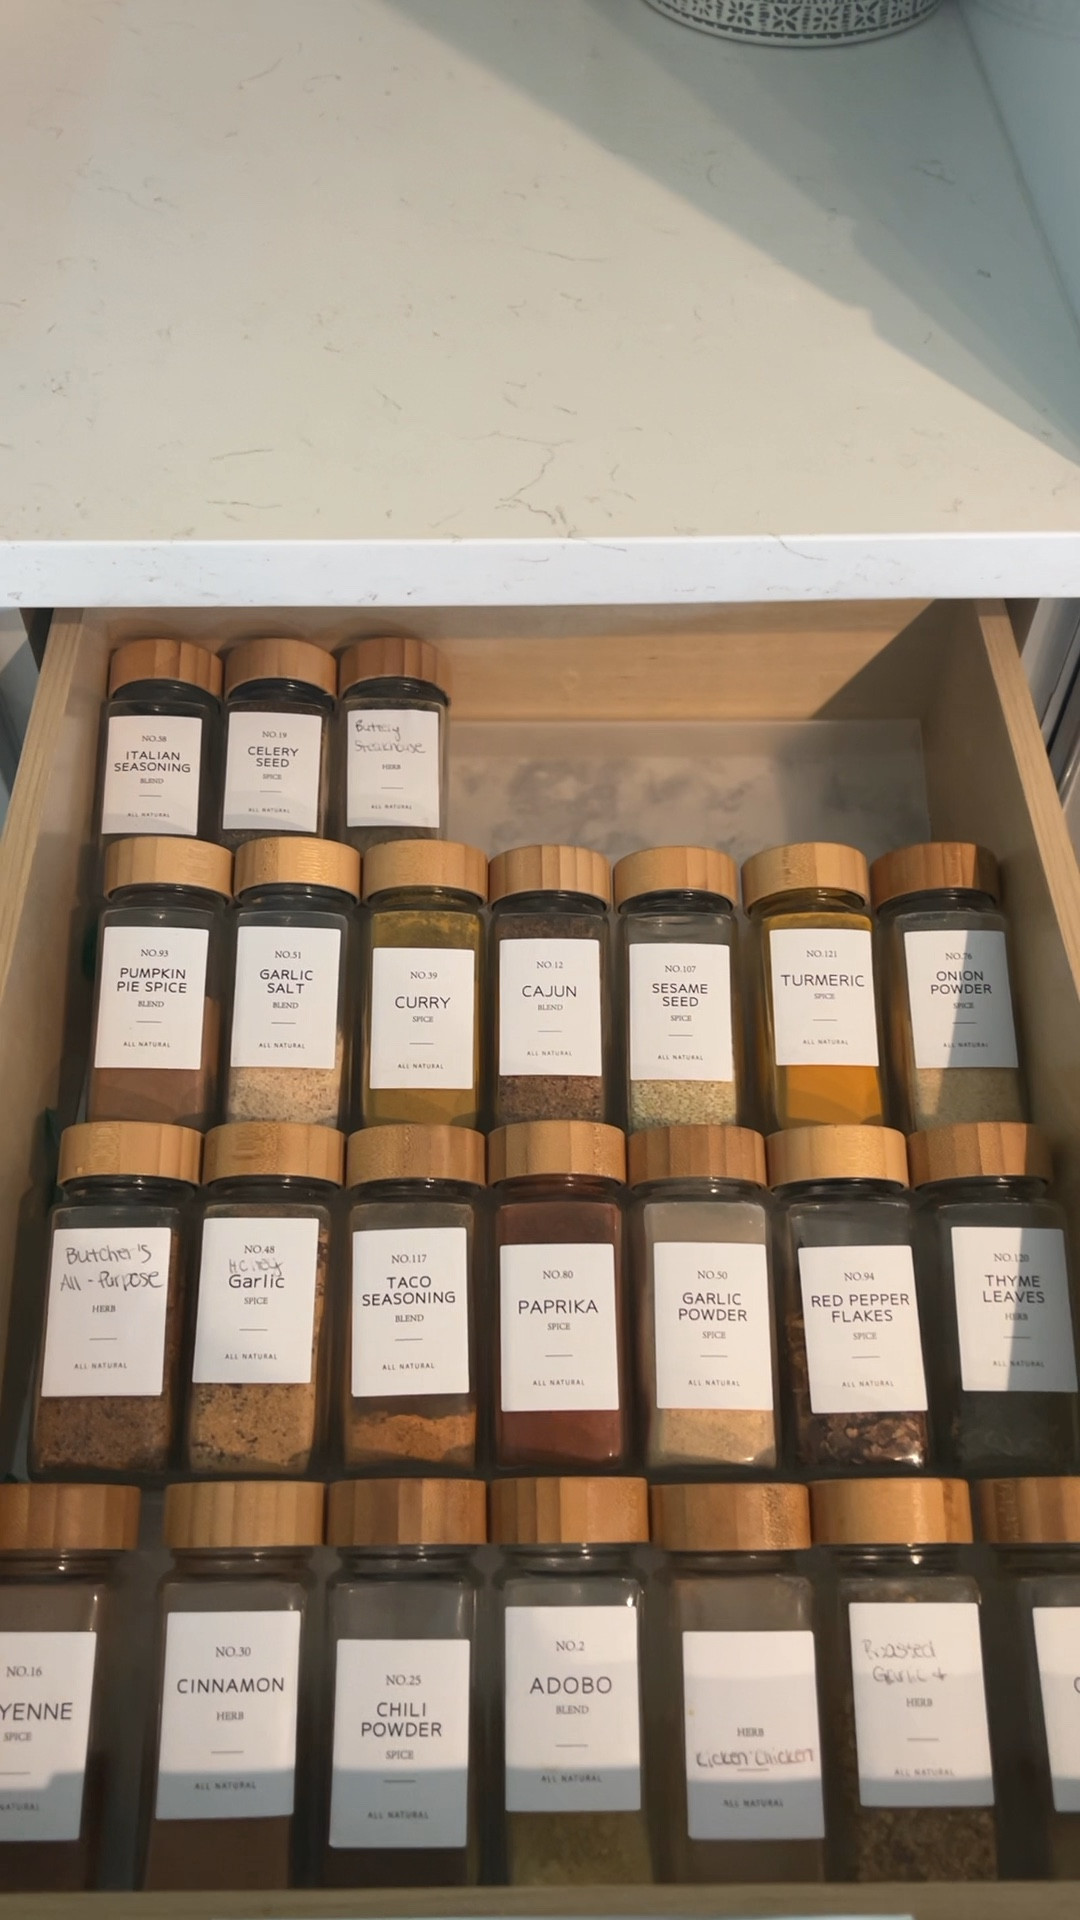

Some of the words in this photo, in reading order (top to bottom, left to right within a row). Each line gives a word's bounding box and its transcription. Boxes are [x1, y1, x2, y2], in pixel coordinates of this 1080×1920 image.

[248, 746, 299, 756] CELERY
[126, 751, 180, 763] ITALIAN
[114, 762, 190, 773] SEASONING
[256, 758, 289, 767] SEED
[141, 949, 168, 957] NO.93
[275, 951, 301, 959] NO.51
[806, 950, 837, 958] NO.121
[536, 961, 563, 969] NO.12
[665, 965, 696, 973] NO.107
[120, 968, 185, 982] PUMPKIN
[260, 969, 313, 981] GARLIC
[411, 971, 438, 979] NO.39
[936, 971, 983, 981] ONION
[781, 974, 864, 987] TURMERIC
[117, 981, 140, 992] PIE
[145, 981, 187, 993] SPICE
[267, 983, 304, 994] SALT
[522, 986, 576, 997] CAJUN
[652, 983, 707, 997] SESAME
[931, 984, 992, 994] POWDER
[395, 996, 450, 1008] CURRY
[662, 996, 698, 1007] SEED
[244, 1245, 275, 1254] NO.48
[392, 1254, 427, 1264] NO.117
[993, 1253, 1029, 1262] NO.120
[543, 1270, 573, 1279] NO.80
[697, 1270, 728, 1280] NO.50
[844, 1272, 874, 1281] NO.94
[229, 1272, 284, 1288] Garlic
[387, 1276, 431, 1288] TACO
[984, 1275, 1040, 1287] THYME
[244, 1297, 268, 1305] SPICE
[362, 1291, 455, 1306] SEASONING
[683, 1292, 741, 1305] GARLIC
[811, 1295, 843, 1307] RED
[849, 1293, 910, 1306] PEPPER
[983, 1290, 1044, 1303] LEAVES
[519, 1300, 598, 1314] PAPRIKA
[395, 1314, 424, 1323] BLEND
[679, 1308, 747, 1321] POWDER
[832, 1310, 893, 1323] FLAKES
[547, 1322, 570, 1330] SPICE
[702, 1331, 726, 1339] SPICE
[853, 1332, 877, 1340] SPICE
[556, 1641, 584, 1651] NO.2
[216, 1646, 251, 1657] NO.30
[6, 1666, 42, 1677] NO.16
[386, 1675, 421, 1686] NO.25
[530, 1676, 612, 1694] ADOBO
[177, 1678, 284, 1694] CINNAMON
[906, 1698, 933, 1707] HERB
[377, 1702, 426, 1717] CHILI
[556, 1705, 589, 1715] BLEND
[217, 1711, 244, 1721] HERB
[361, 1722, 441, 1737] POWDER
[737, 1727, 764, 1737] HERB
[3, 1732, 32, 1742] SPICE
[386, 1750, 414, 1760] SPICE
[894, 1768, 910, 1776] ALL
[914, 1768, 953, 1776] NATURAL
[541, 1775, 557, 1783] ALL
[561, 1774, 602, 1782] NATURAL
[194, 1783, 210, 1791] ALL
[215, 1781, 256, 1790] NATURAL
[723, 1800, 739, 1808] ALL
[743, 1799, 783, 1808] NATURAL
[368, 1812, 383, 1820] ALL
[387, 1811, 429, 1819] NATURAL
